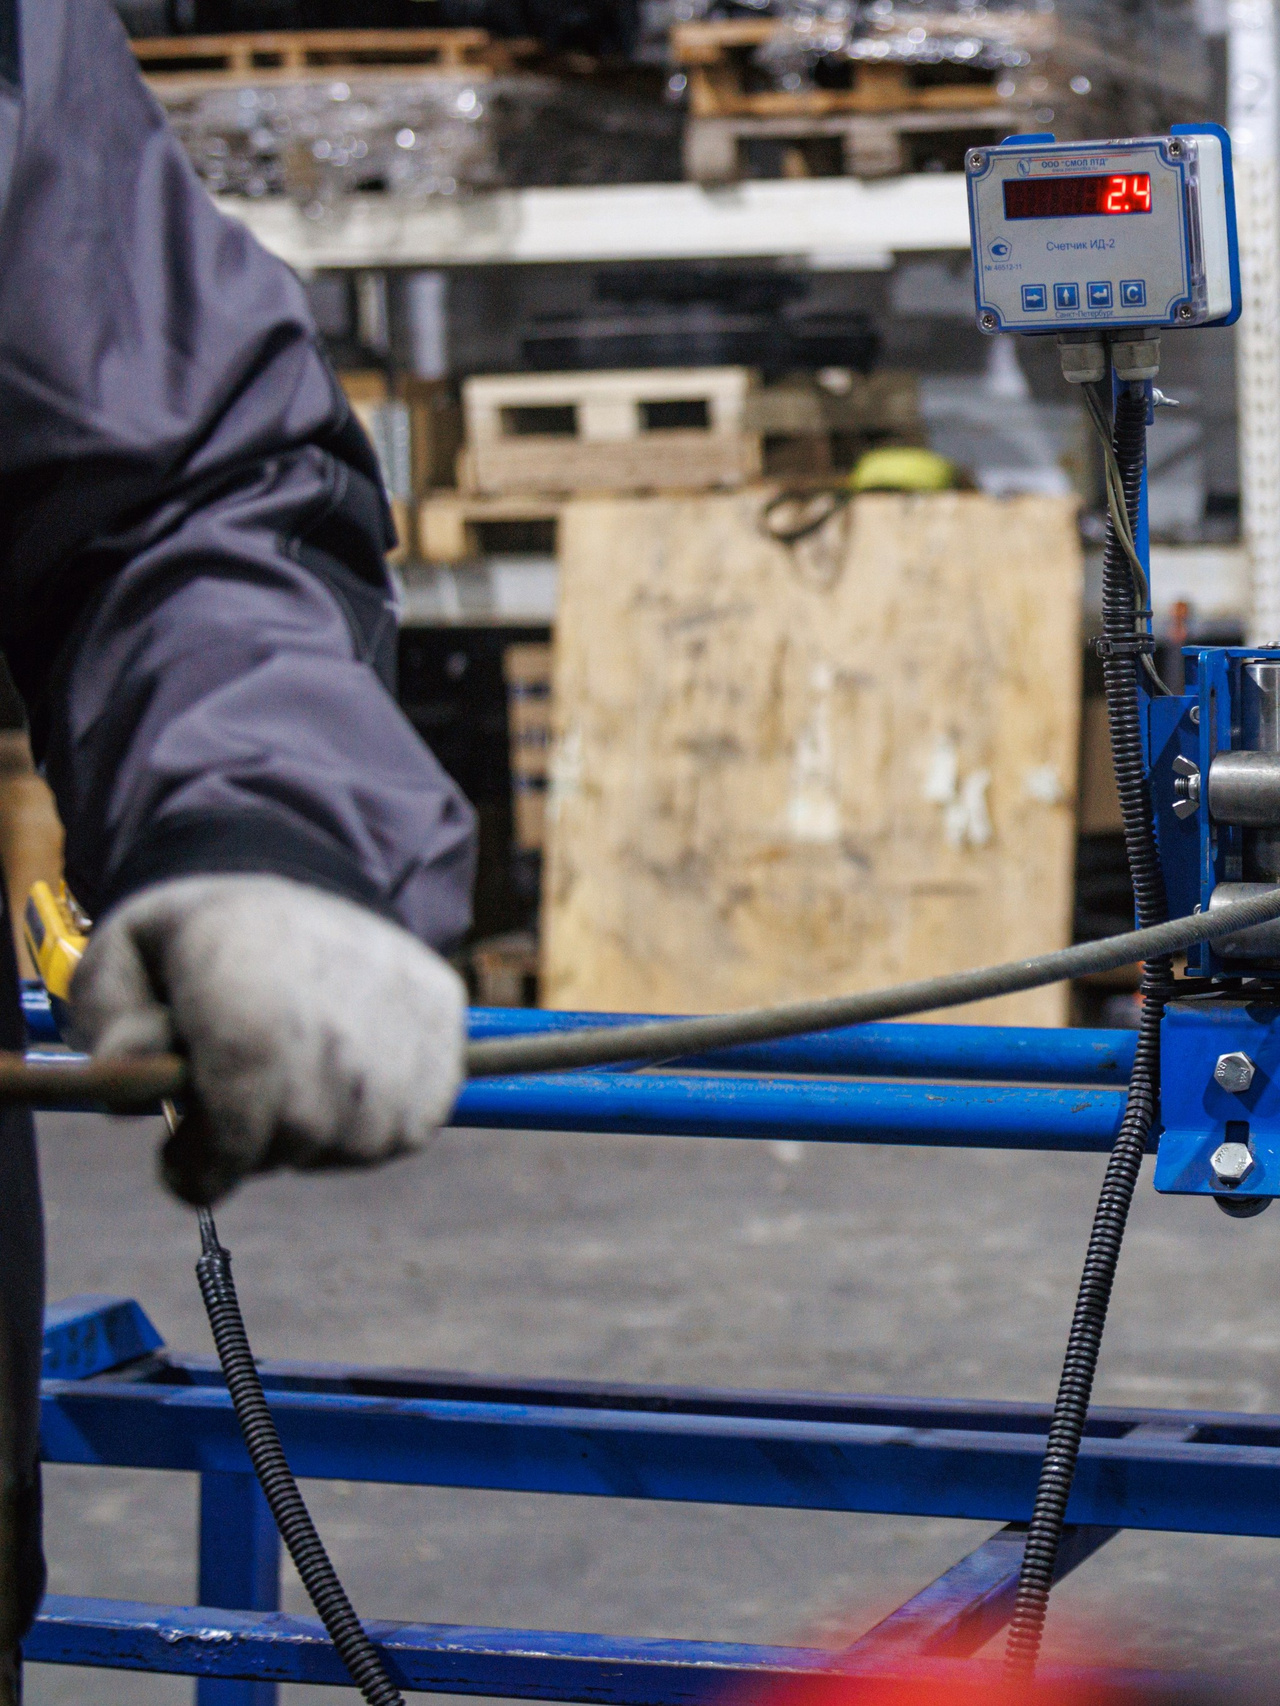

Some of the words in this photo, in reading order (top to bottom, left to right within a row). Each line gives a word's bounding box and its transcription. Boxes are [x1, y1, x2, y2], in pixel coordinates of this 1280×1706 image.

[1041, 160, 1060, 169] ООО
[1046, 241, 1088, 252] Счетчик
[1090, 238, 1116, 250] ИД-2
[1055, 310, 1114, 319] Санкт-Петербург
